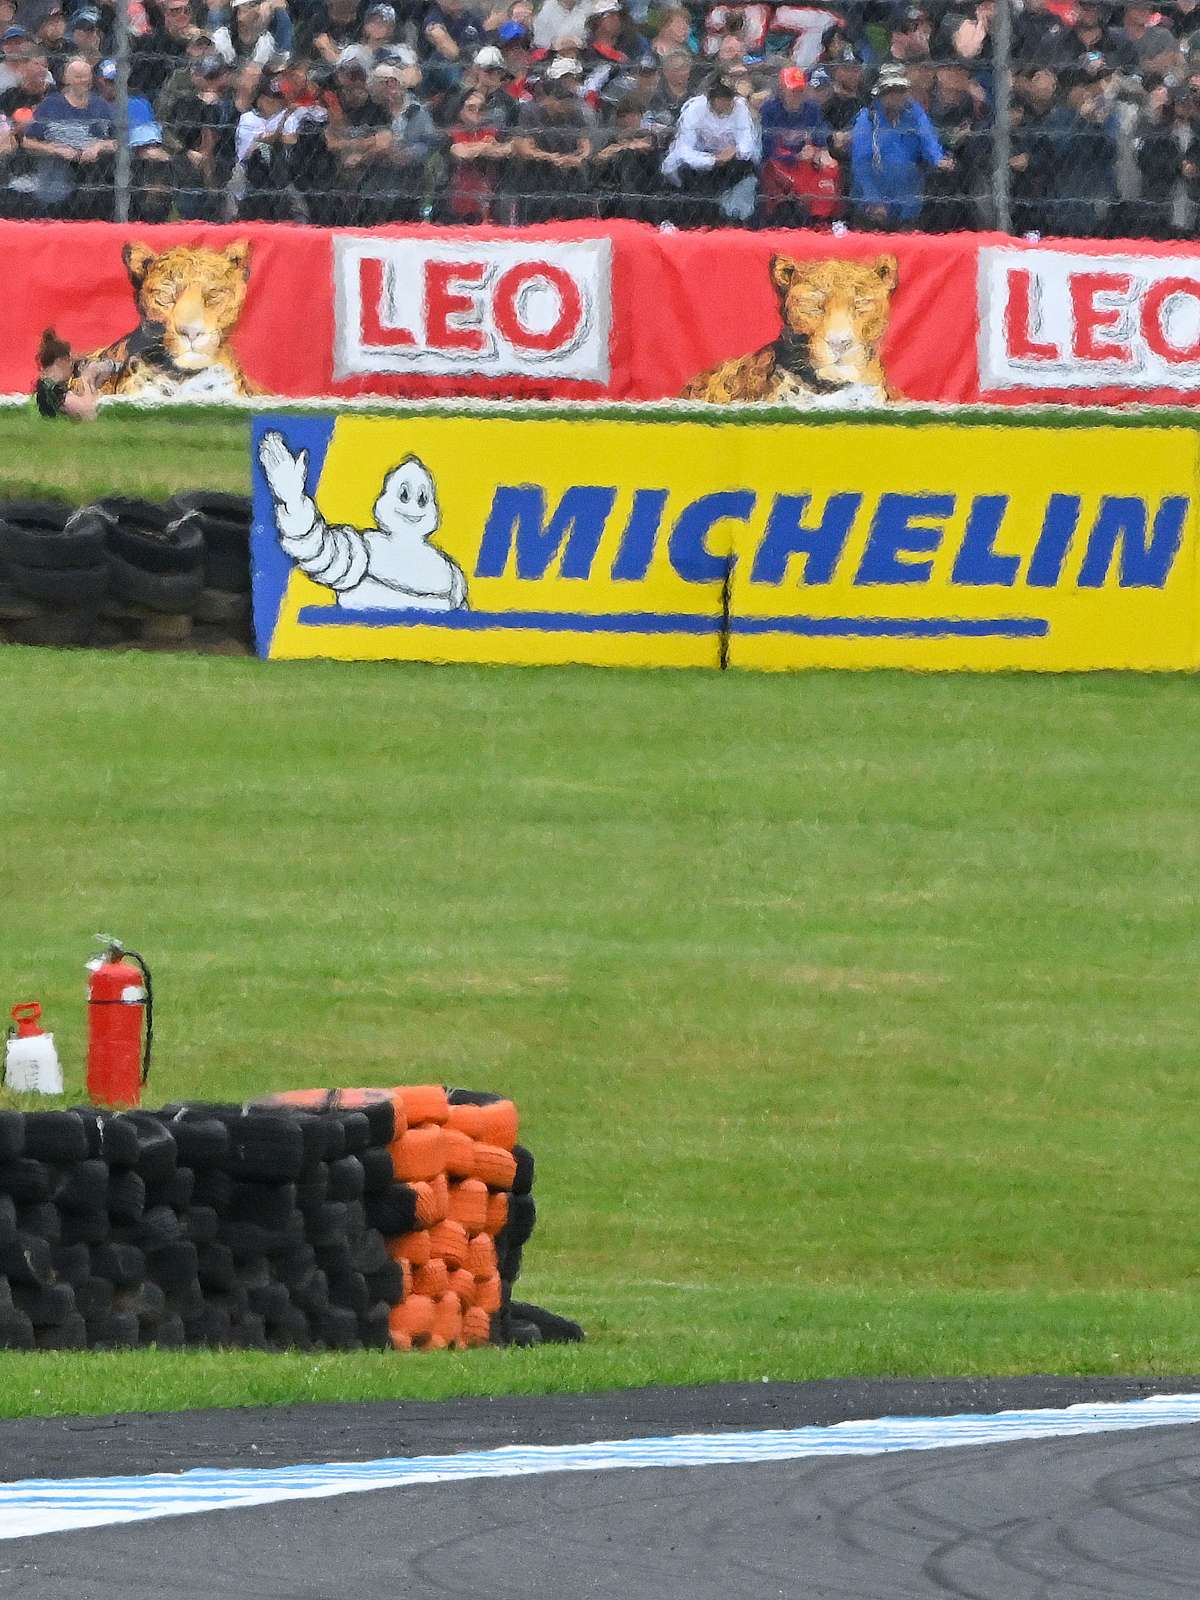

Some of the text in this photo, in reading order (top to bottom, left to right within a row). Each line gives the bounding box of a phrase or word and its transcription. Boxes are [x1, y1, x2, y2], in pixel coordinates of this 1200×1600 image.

[359, 257, 581, 352] LEO
[1005, 268, 1200, 365] LEO
[474, 484, 1190, 589] MICHELIN
